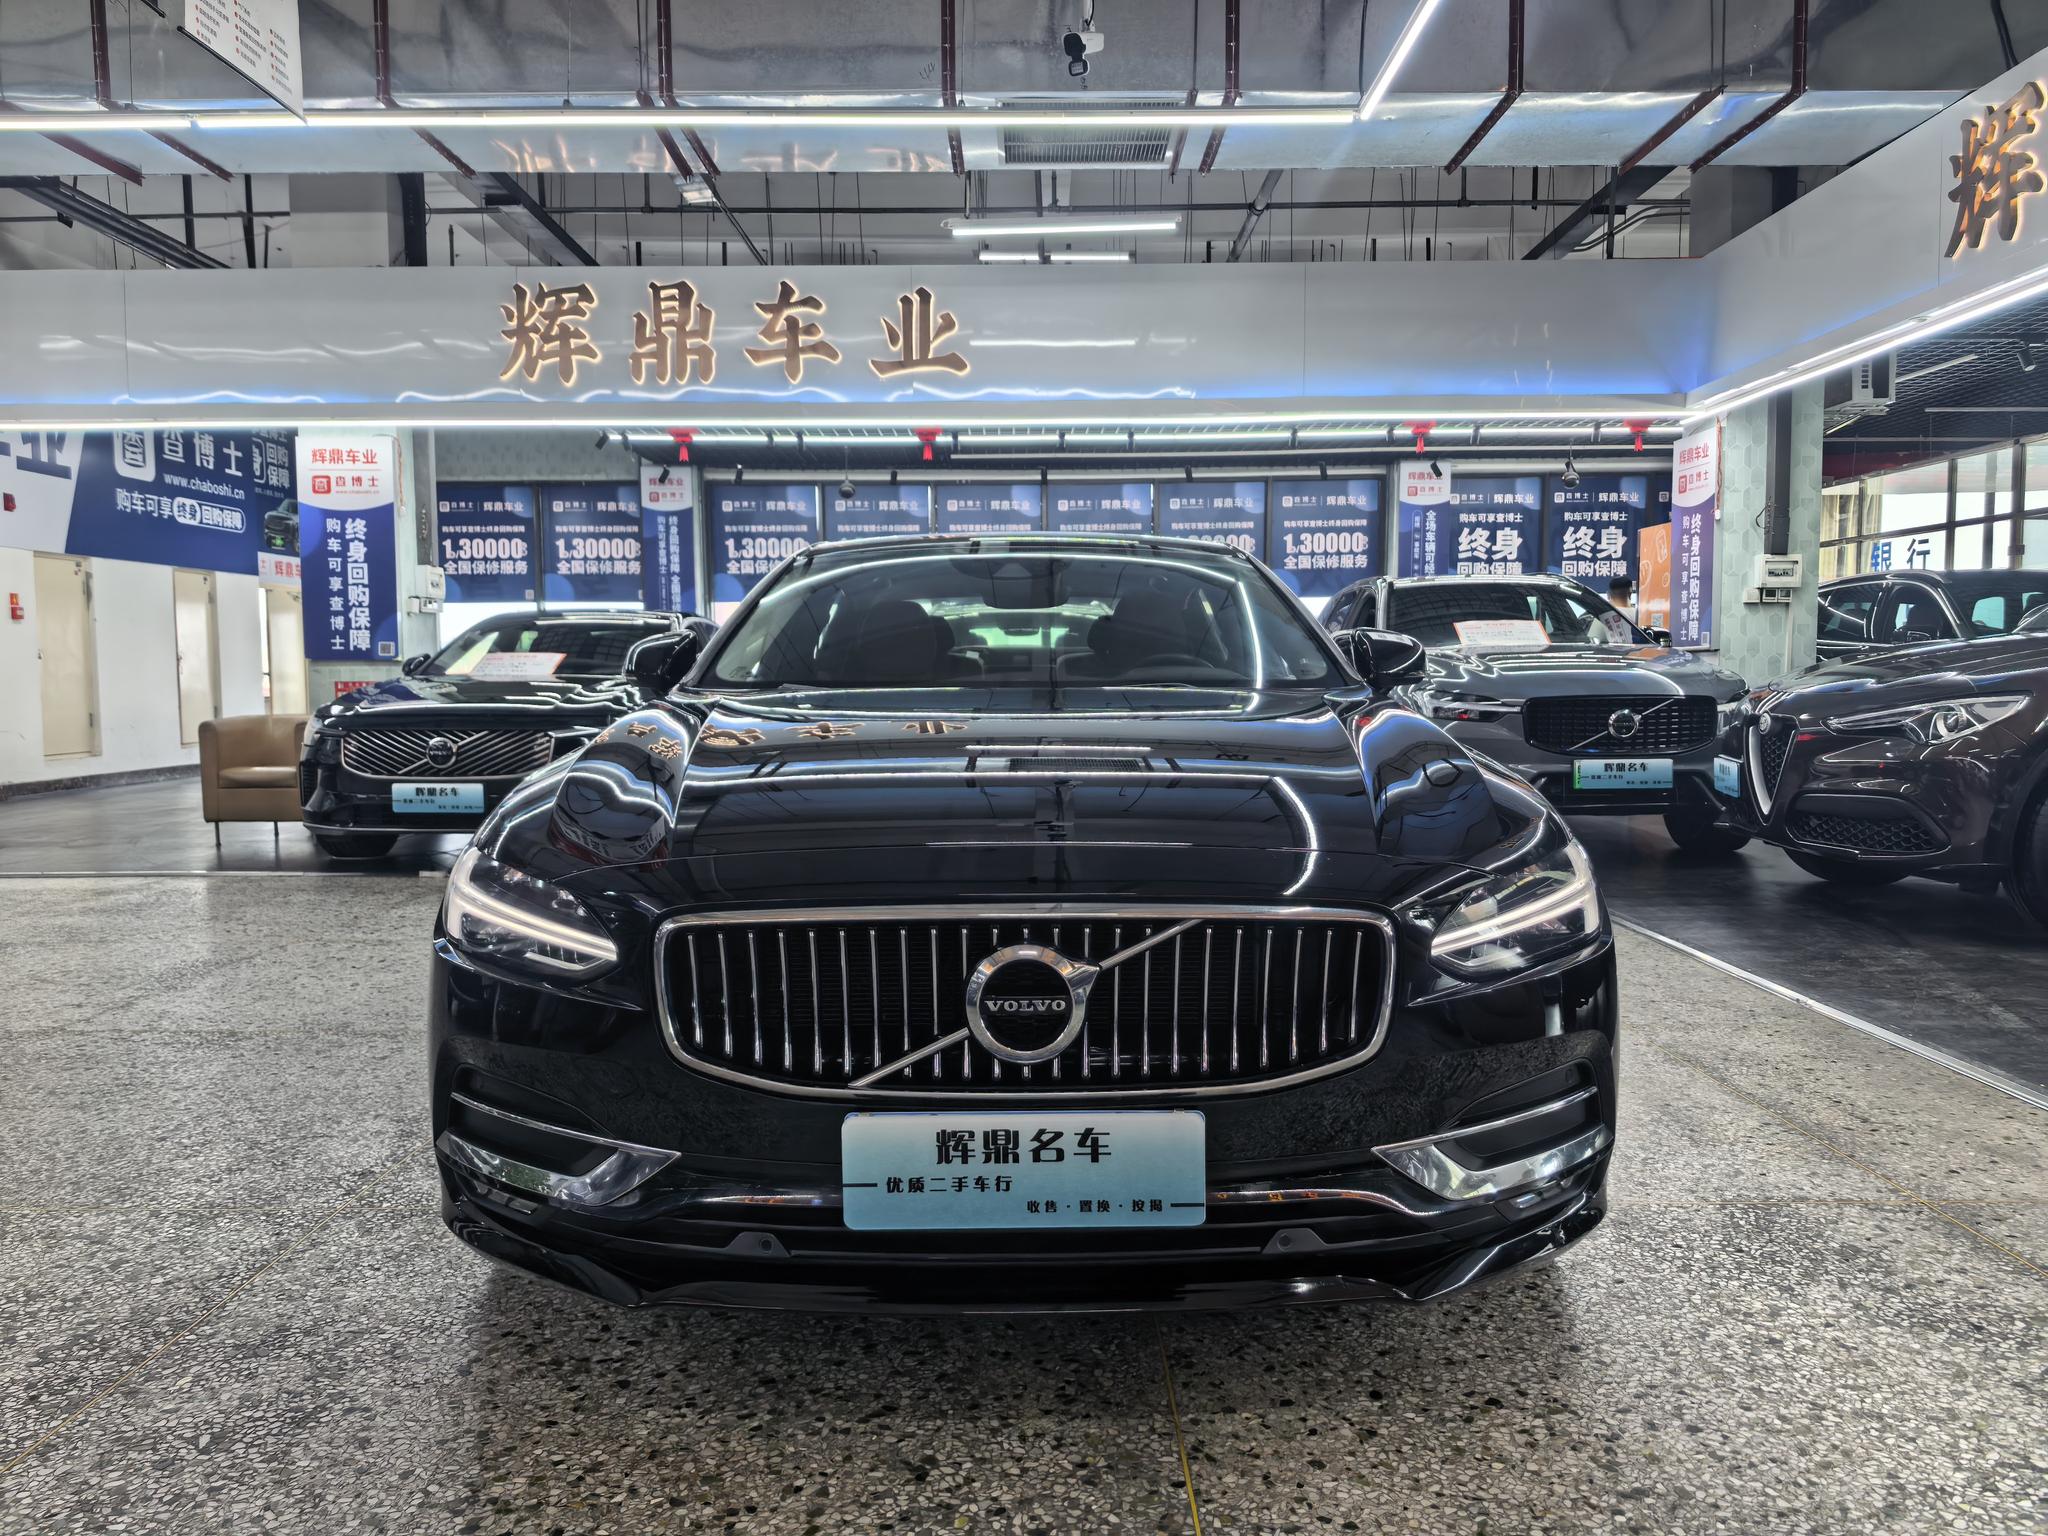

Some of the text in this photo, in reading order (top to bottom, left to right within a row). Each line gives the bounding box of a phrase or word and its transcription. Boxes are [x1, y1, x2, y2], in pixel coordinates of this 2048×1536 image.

[1944, 81, 2045, 258] 辉
[499, 279, 971, 387] 辉鼎车业
[0, 430, 73, 480] 业
[312, 448, 378, 465] 辉鼎车业
[1679, 443, 1710, 466] 辉鼎车业
[163, 473, 246, 500] www.chaboshi.cn
[1598, 492, 1639, 502] 辉鼎车业
[1494, 493, 1534, 504] 辉鼎车业
[1459, 513, 1523, 523] 购车可享查博士
[1564, 512, 1628, 521] 购车可享查博士
[1458, 527, 1523, 560] 终身
[1562, 526, 1627, 559] 终身
[1284, 555, 1368, 569] 全国保修服务
[1871, 538, 1931, 572] 银行
[444, 561, 528, 575] 全国保修服务
[556, 560, 641, 575] 全国保修服务
[1457, 562, 1522, 575] 回购保障
[1562, 560, 1627, 577] 回购保障
[1680, 515, 1690, 641] 购车可享查博士
[1688, 513, 1702, 641] 终身回购保障
[326, 517, 346, 651] 购车可享查博士
[345, 517, 371, 652] 终身回购保障
[984, 1000, 1067, 1012] VOLVO
[935, 1127, 1112, 1165] 辉鼎名车
[886, 1175, 1013, 1194] 优质二手车行
